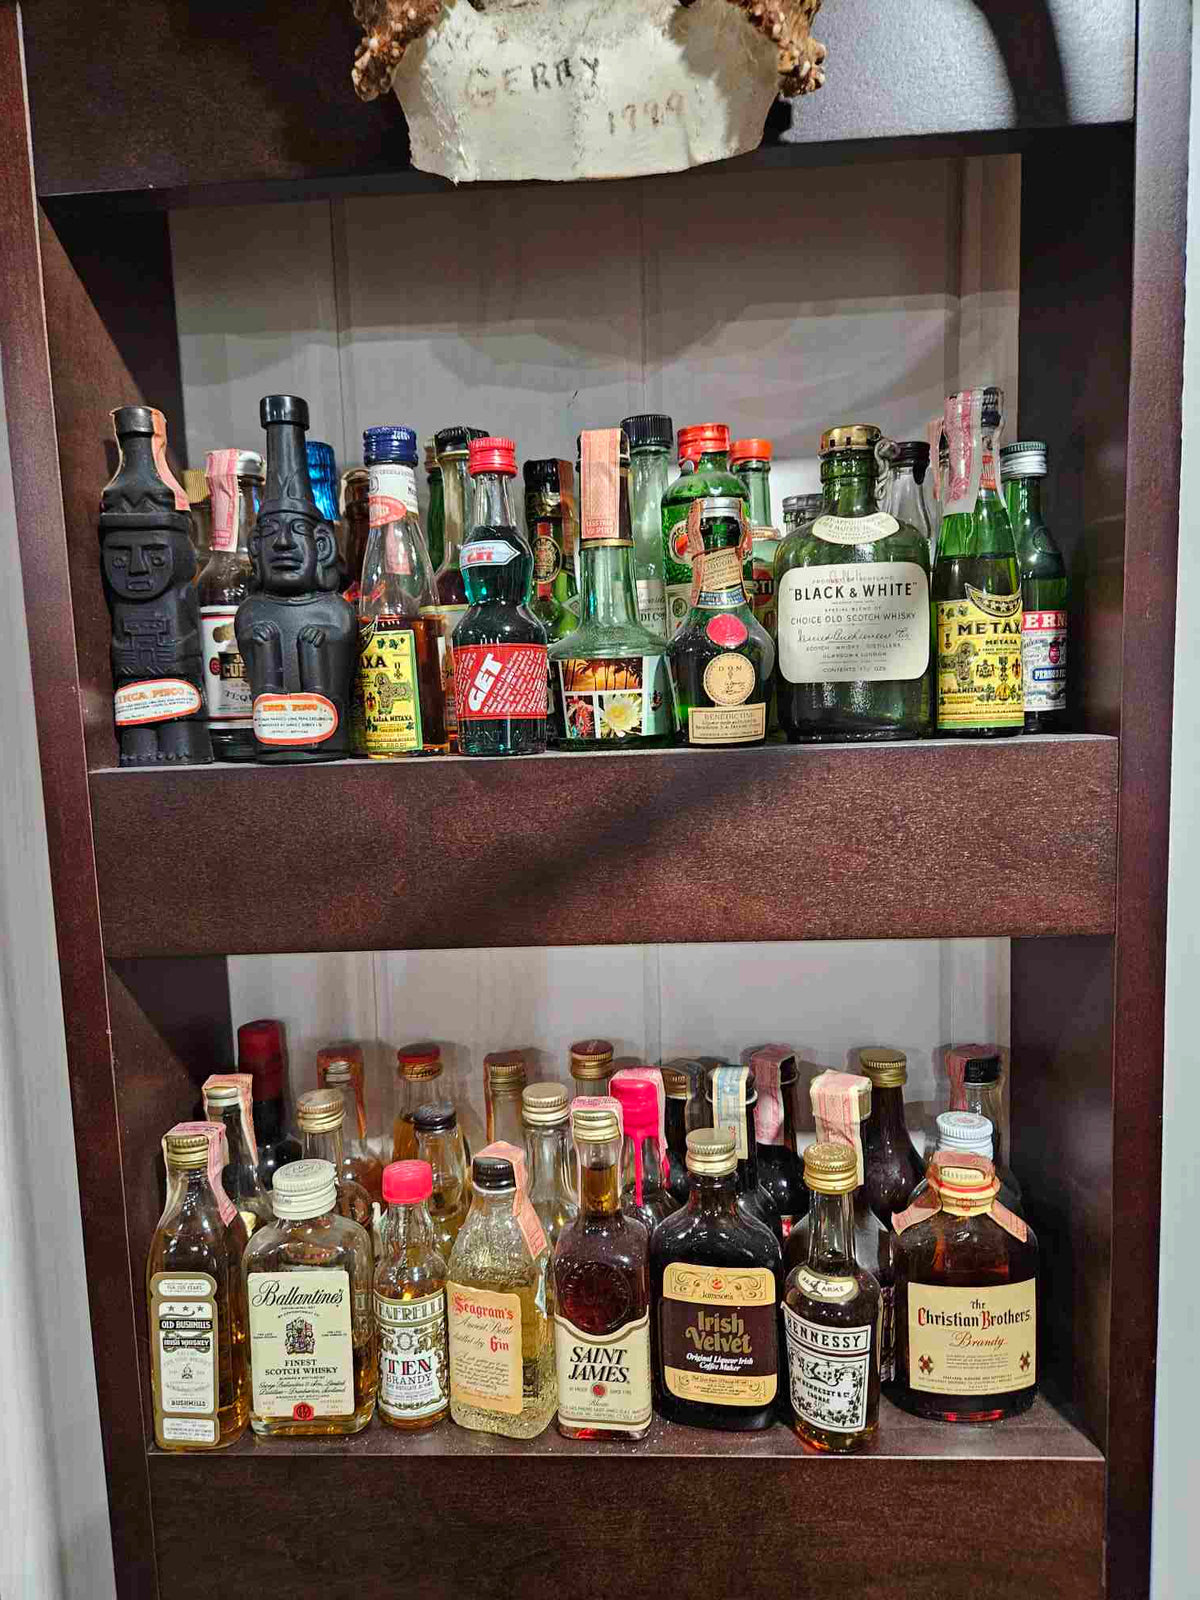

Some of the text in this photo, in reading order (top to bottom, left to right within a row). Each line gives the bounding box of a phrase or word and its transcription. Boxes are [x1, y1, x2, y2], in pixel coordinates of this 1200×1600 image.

[849, 587, 858, 599] &
[790, 611, 917, 626] CHOICE OLD SCOTCH WHISKY
[468, 652, 503, 711] GET
[252, 1280, 344, 1307] Ballantine's
[451, 1292, 515, 1320] Seagram's
[161, 1320, 175, 1329] OLD
[697, 1310, 745, 1336] Irish
[918, 1305, 1031, 1330] Christian Brothers
[490, 1335, 510, 1352] Gin
[685, 1326, 752, 1354] Velvet
[948, 1331, 1005, 1351] Brandy
[285, 1358, 318, 1367] FINEST
[384, 1356, 432, 1376] TEN
[570, 1346, 628, 1366] SAINT
[686, 1352, 713, 1363] Original
[265, 1366, 338, 1376] SCOTCH WHISKY
[386, 1373, 432, 1385] BRANDY
[568, 1364, 630, 1384] JAMES
